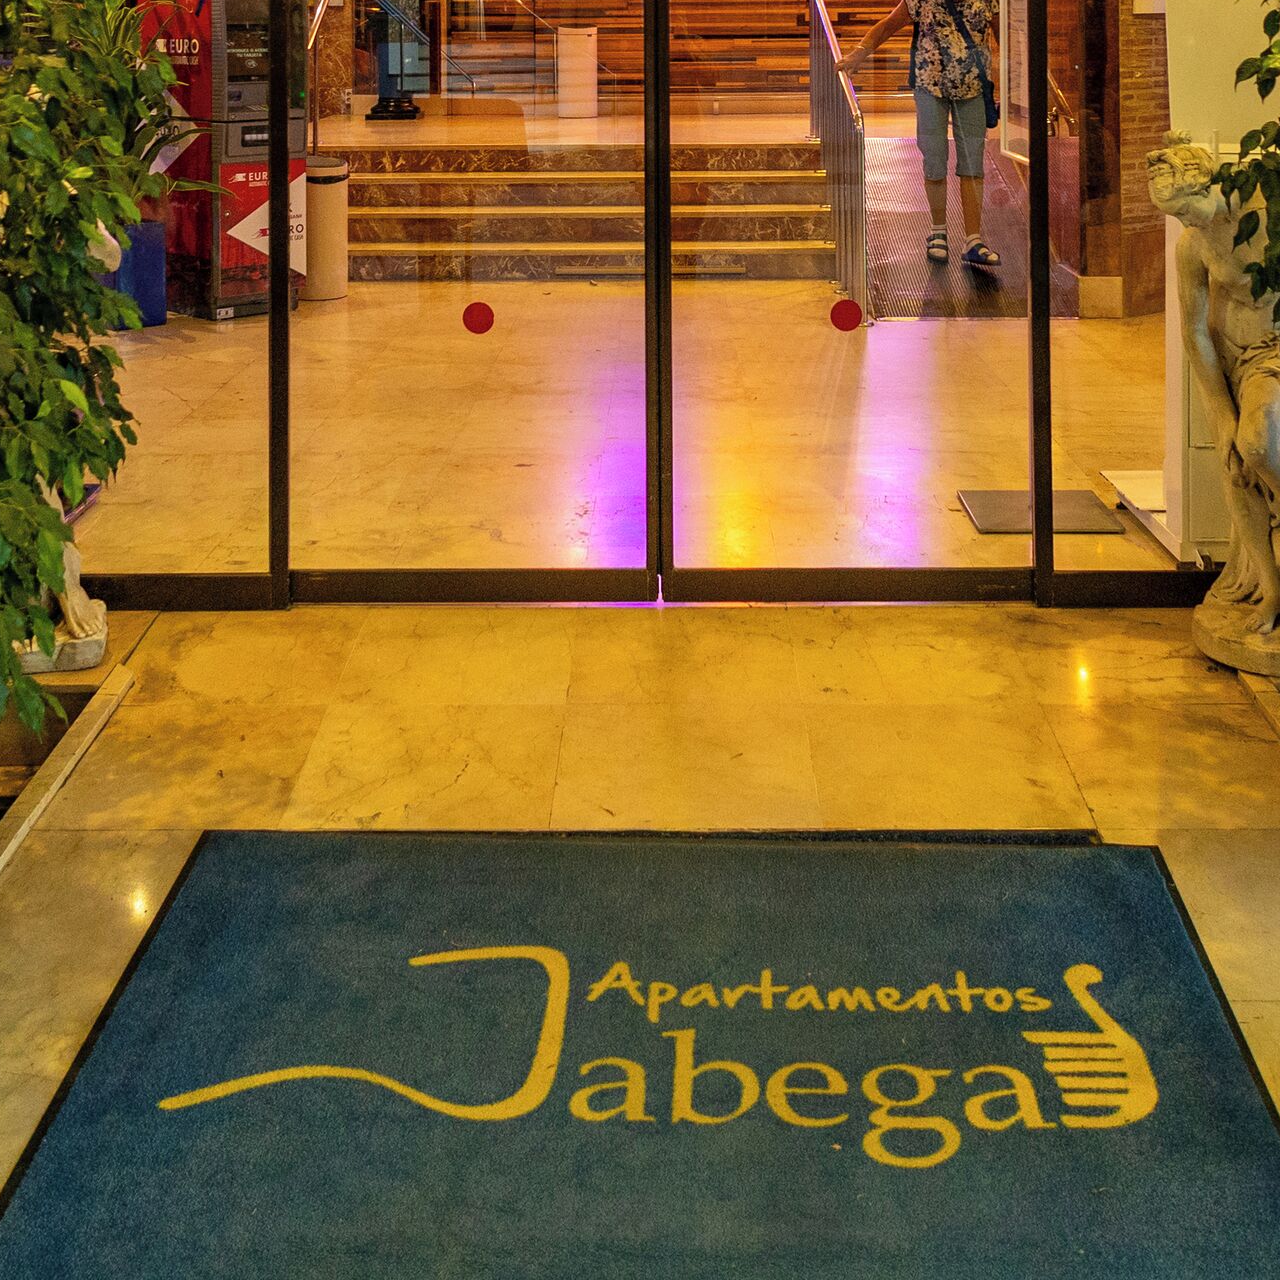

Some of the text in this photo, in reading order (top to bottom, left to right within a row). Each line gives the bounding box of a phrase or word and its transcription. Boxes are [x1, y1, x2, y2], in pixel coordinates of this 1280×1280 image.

[169, 38, 200, 54] EURO
[248, 171, 268, 181] EUR
[289, 223, 304, 234] RO
[586, 961, 1053, 1024] Apartamentos
